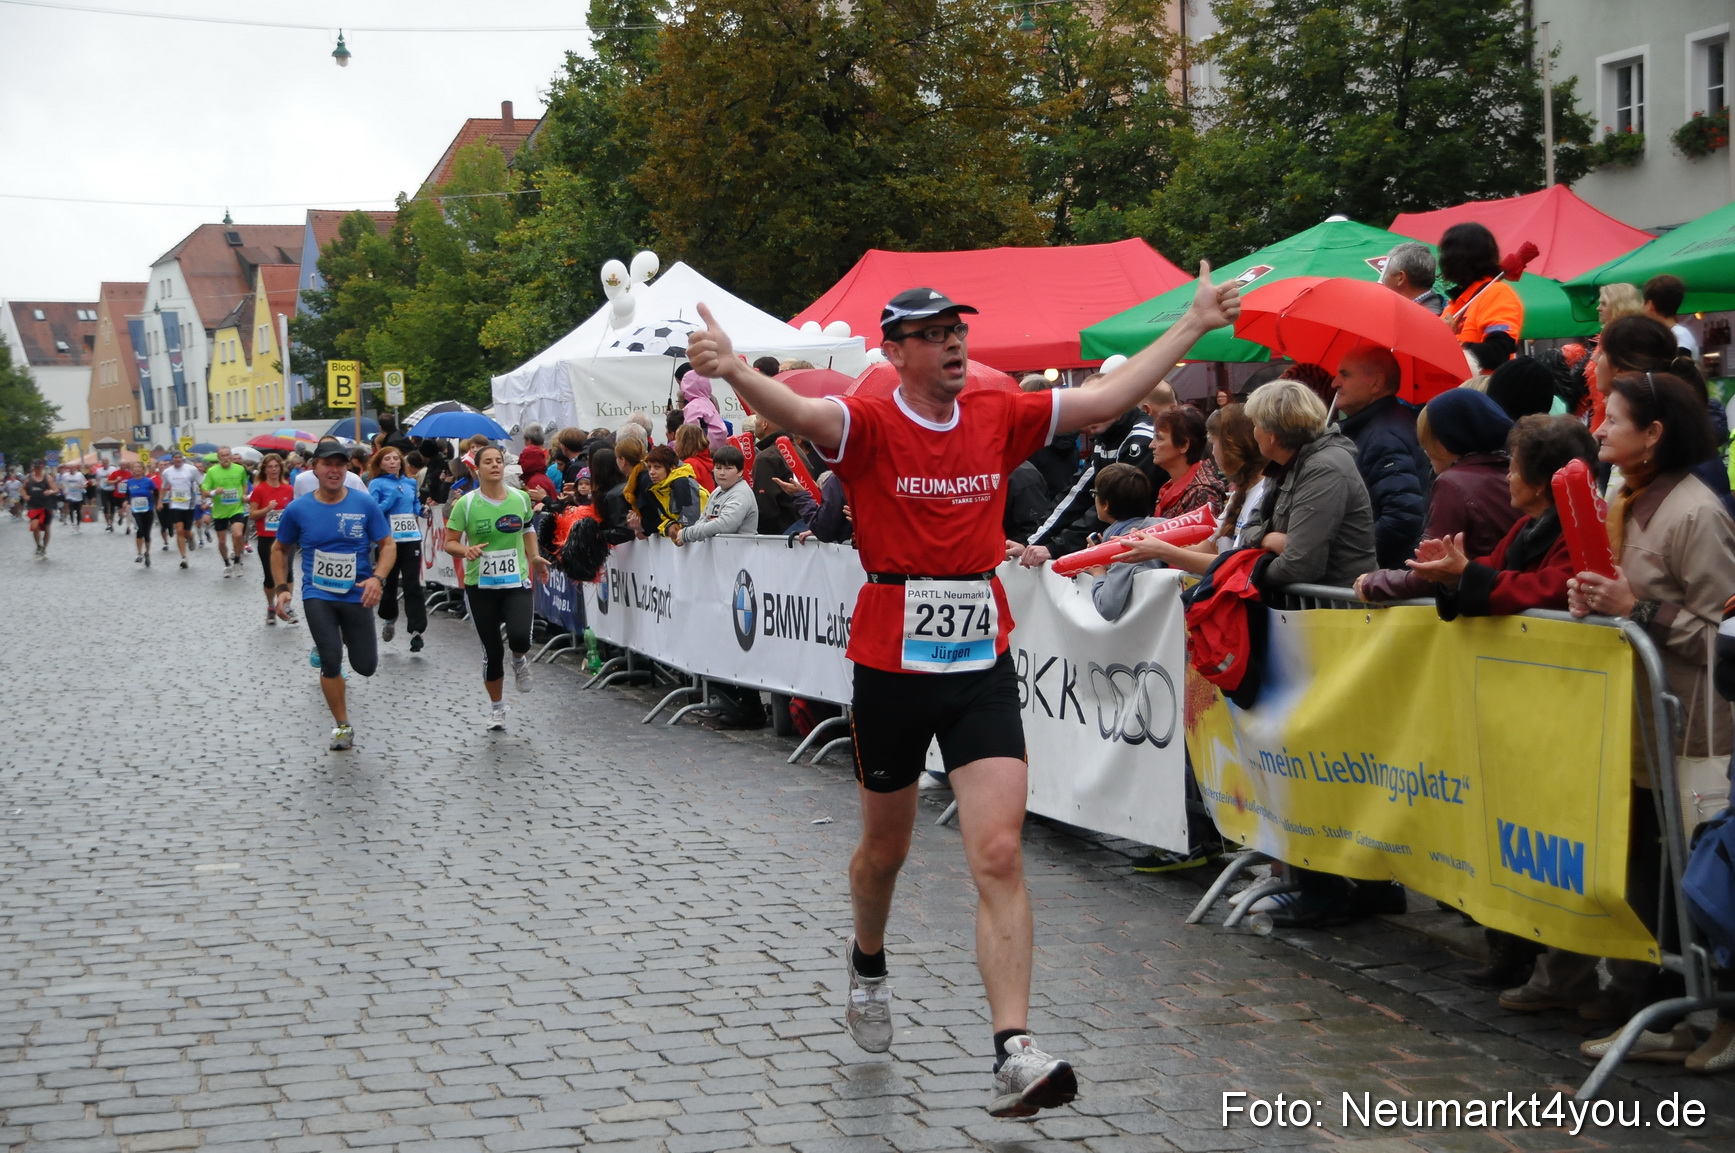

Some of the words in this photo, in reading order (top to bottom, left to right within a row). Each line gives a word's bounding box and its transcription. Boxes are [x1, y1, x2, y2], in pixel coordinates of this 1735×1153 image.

[332, 362, 356, 372] Block
[336, 375, 352, 397] B
[596, 401, 648, 416] Kinder
[896, 474, 989, 495] NEUMARKT
[317, 561, 352, 578] 2632
[483, 559, 516, 575] 2148
[907, 590, 942, 599] PARTL
[943, 590, 984, 599] Neumarkt
[763, 592, 810, 642] BMW
[914, 603, 991, 638] 2374
[931, 646, 971, 662] Jürgen
[1016, 648, 1087, 726] BKK
[1321, 825, 1353, 840] Stufen
[1497, 817, 1585, 897] KANN
